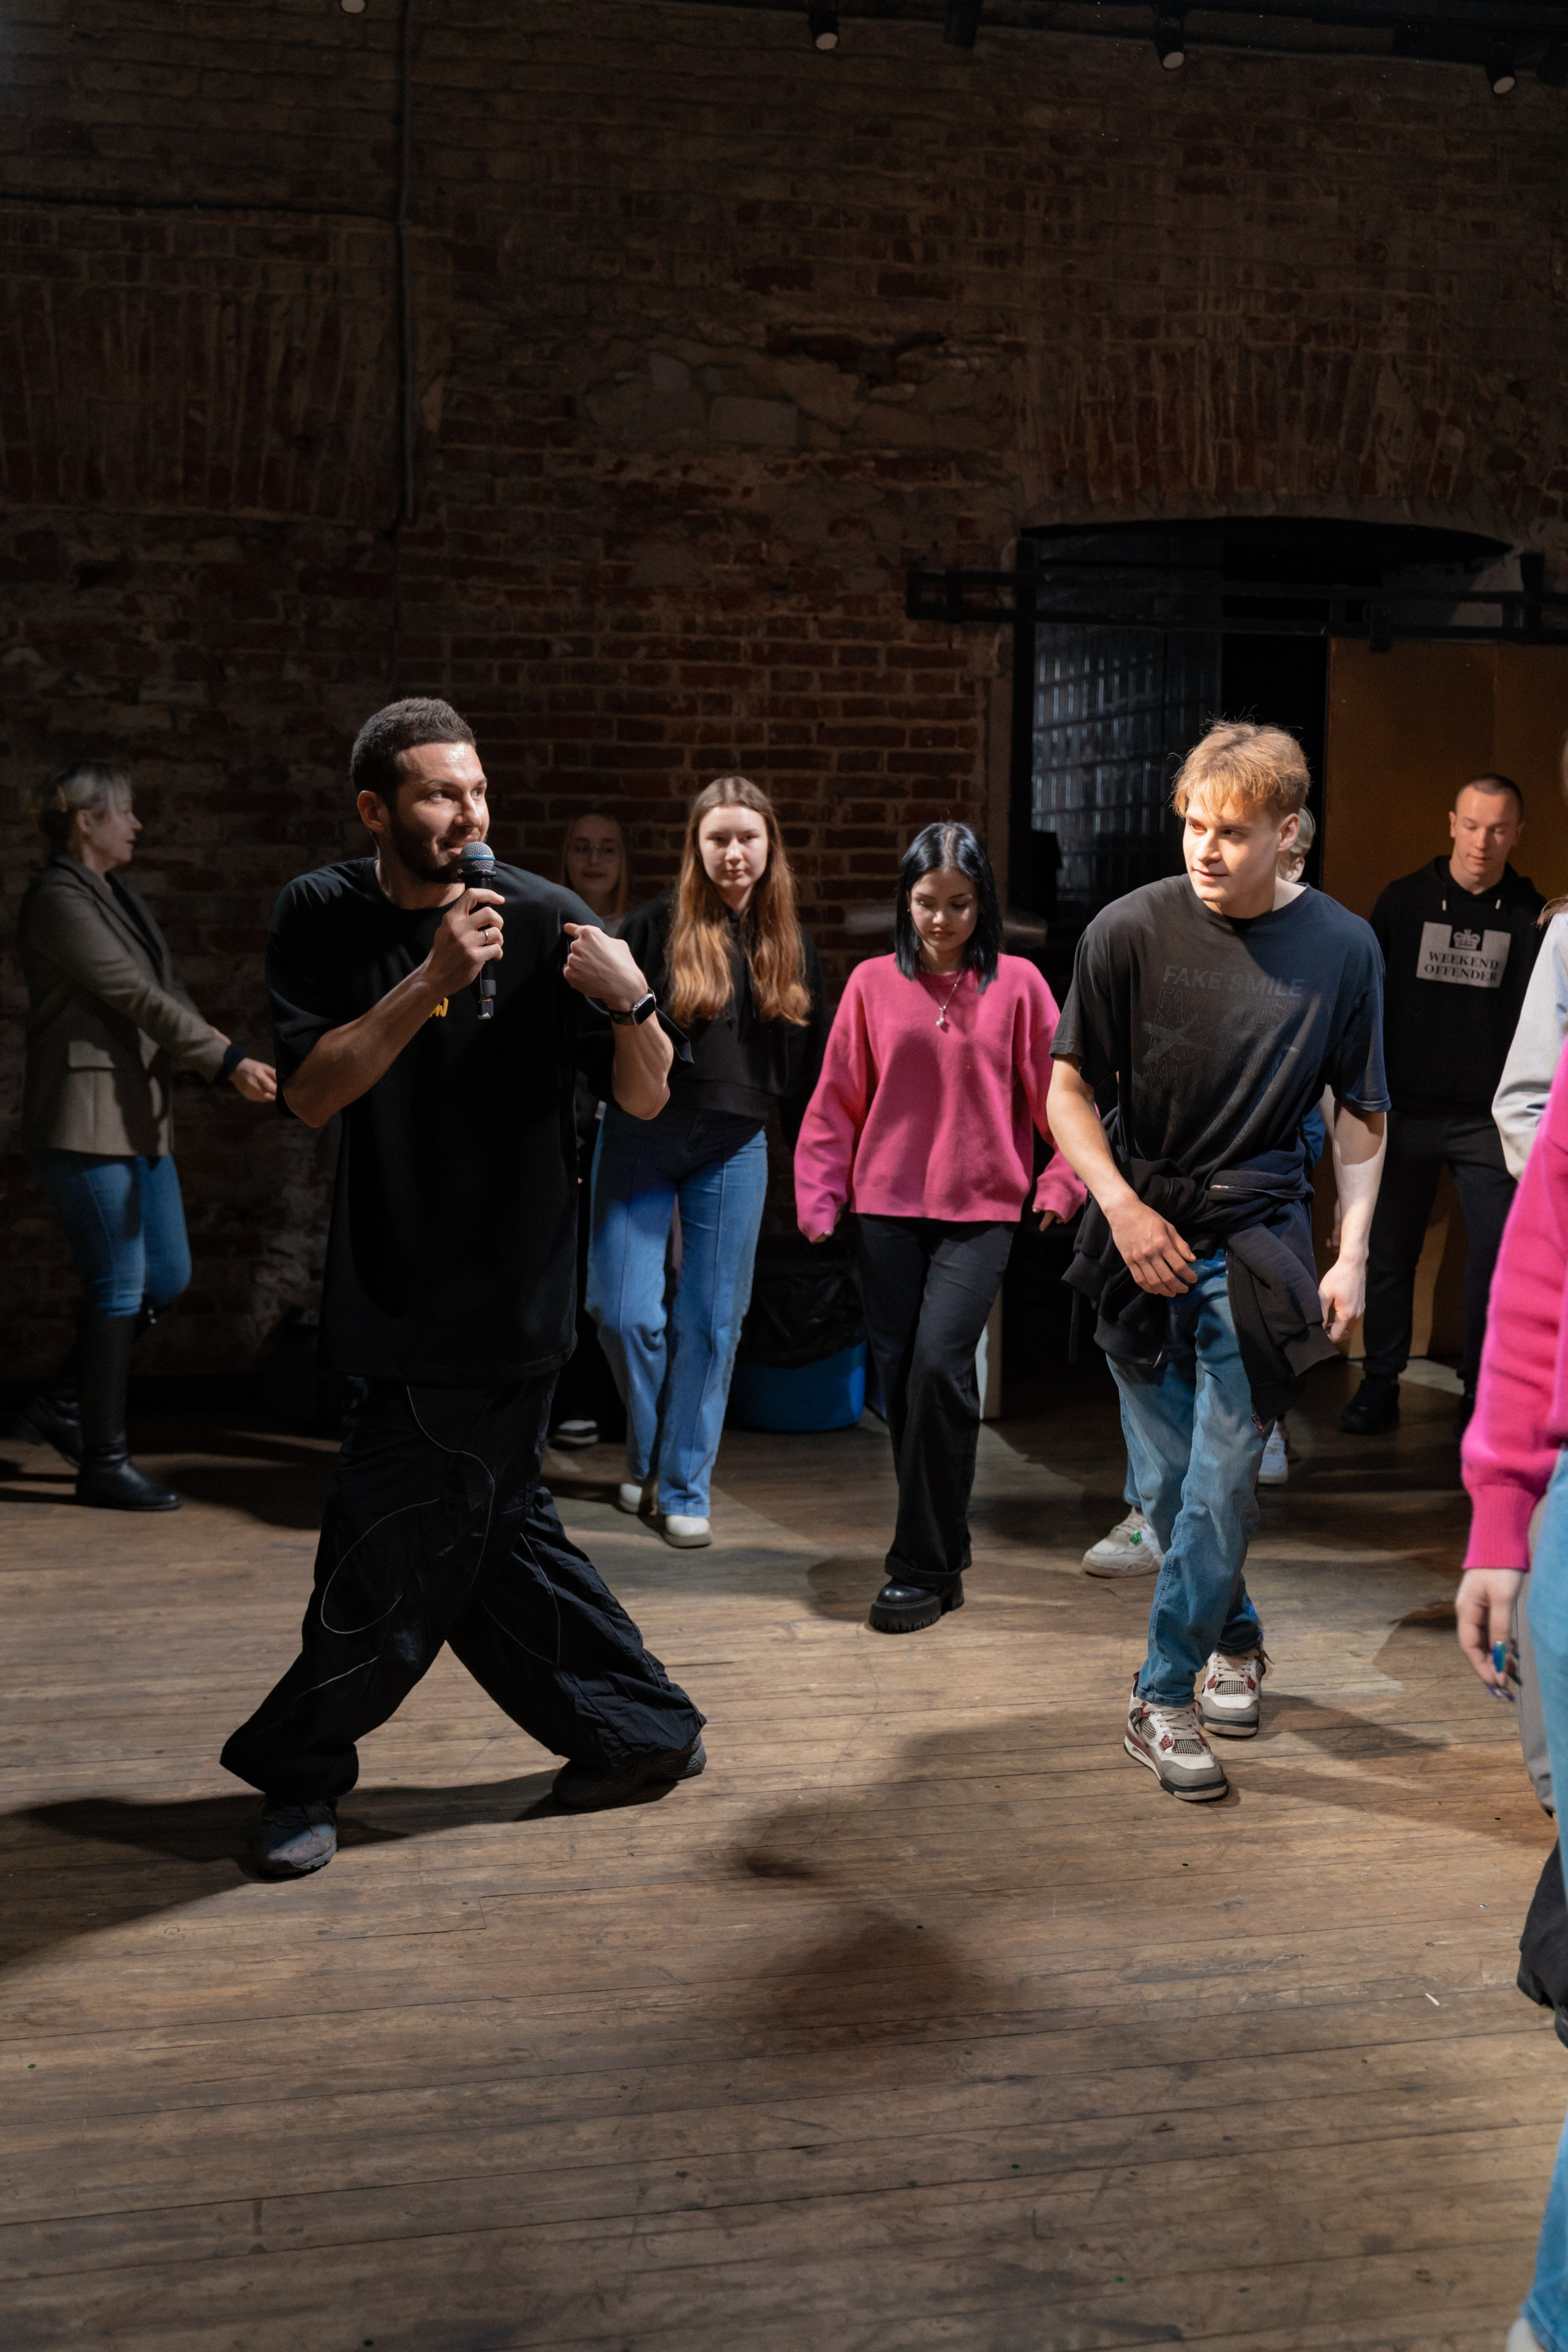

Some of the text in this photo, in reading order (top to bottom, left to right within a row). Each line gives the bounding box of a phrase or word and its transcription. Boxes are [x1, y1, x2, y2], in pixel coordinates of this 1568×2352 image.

[1429, 951, 1499, 969] WEEKEND
[1163, 964, 1305, 997] FAKE SMILE
[1425, 963, 1497, 982] OFFENDER
